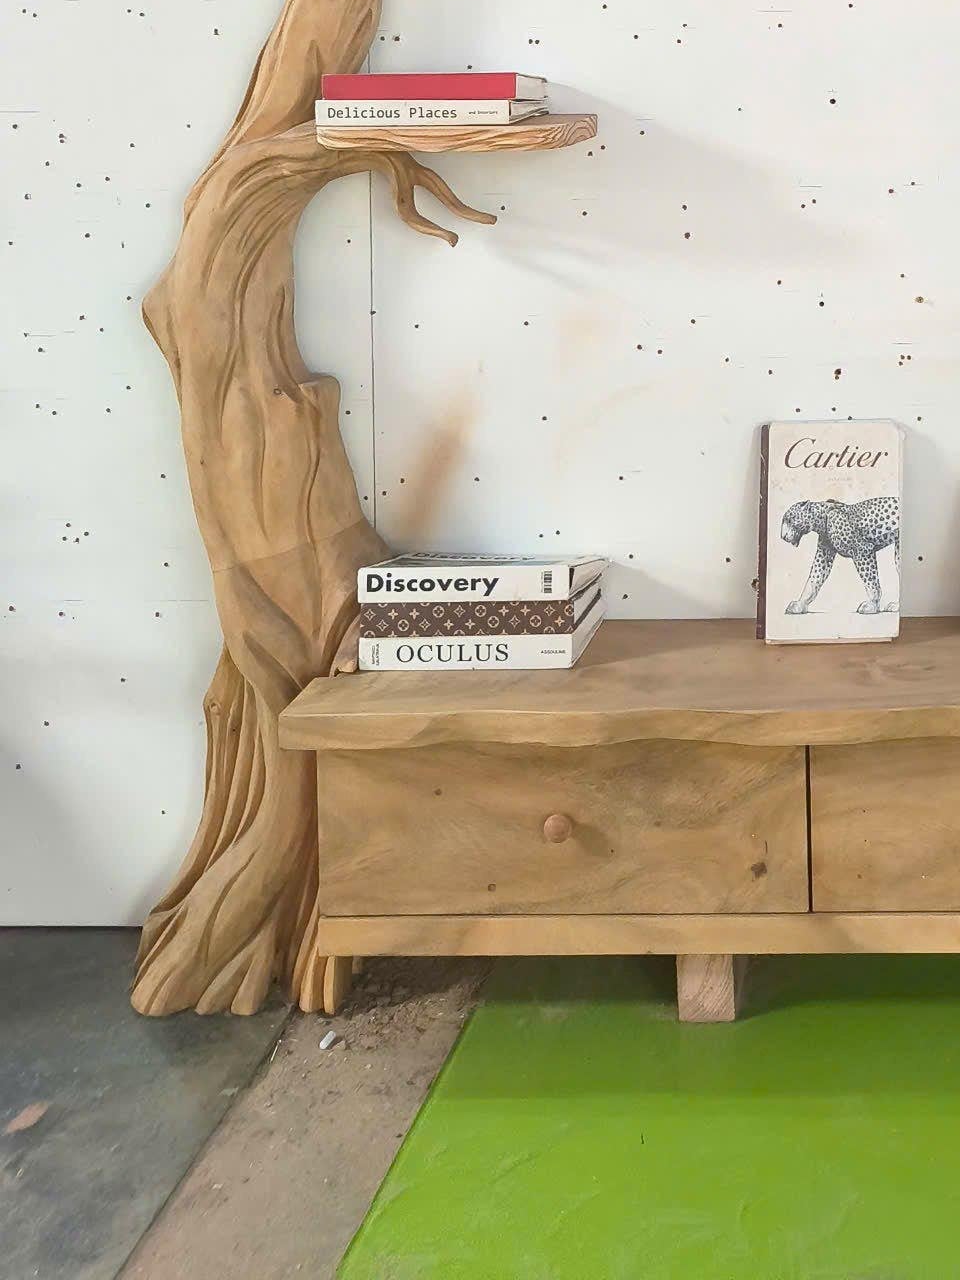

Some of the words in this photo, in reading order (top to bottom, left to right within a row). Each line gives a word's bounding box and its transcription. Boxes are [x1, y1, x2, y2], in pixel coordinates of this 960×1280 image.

[327, 107, 401, 119] Delicious
[409, 107, 458, 118] Places
[784, 437, 889, 469] Cartier
[366, 573, 499, 597] Discovery
[396, 643, 509, 663] OCULUS
